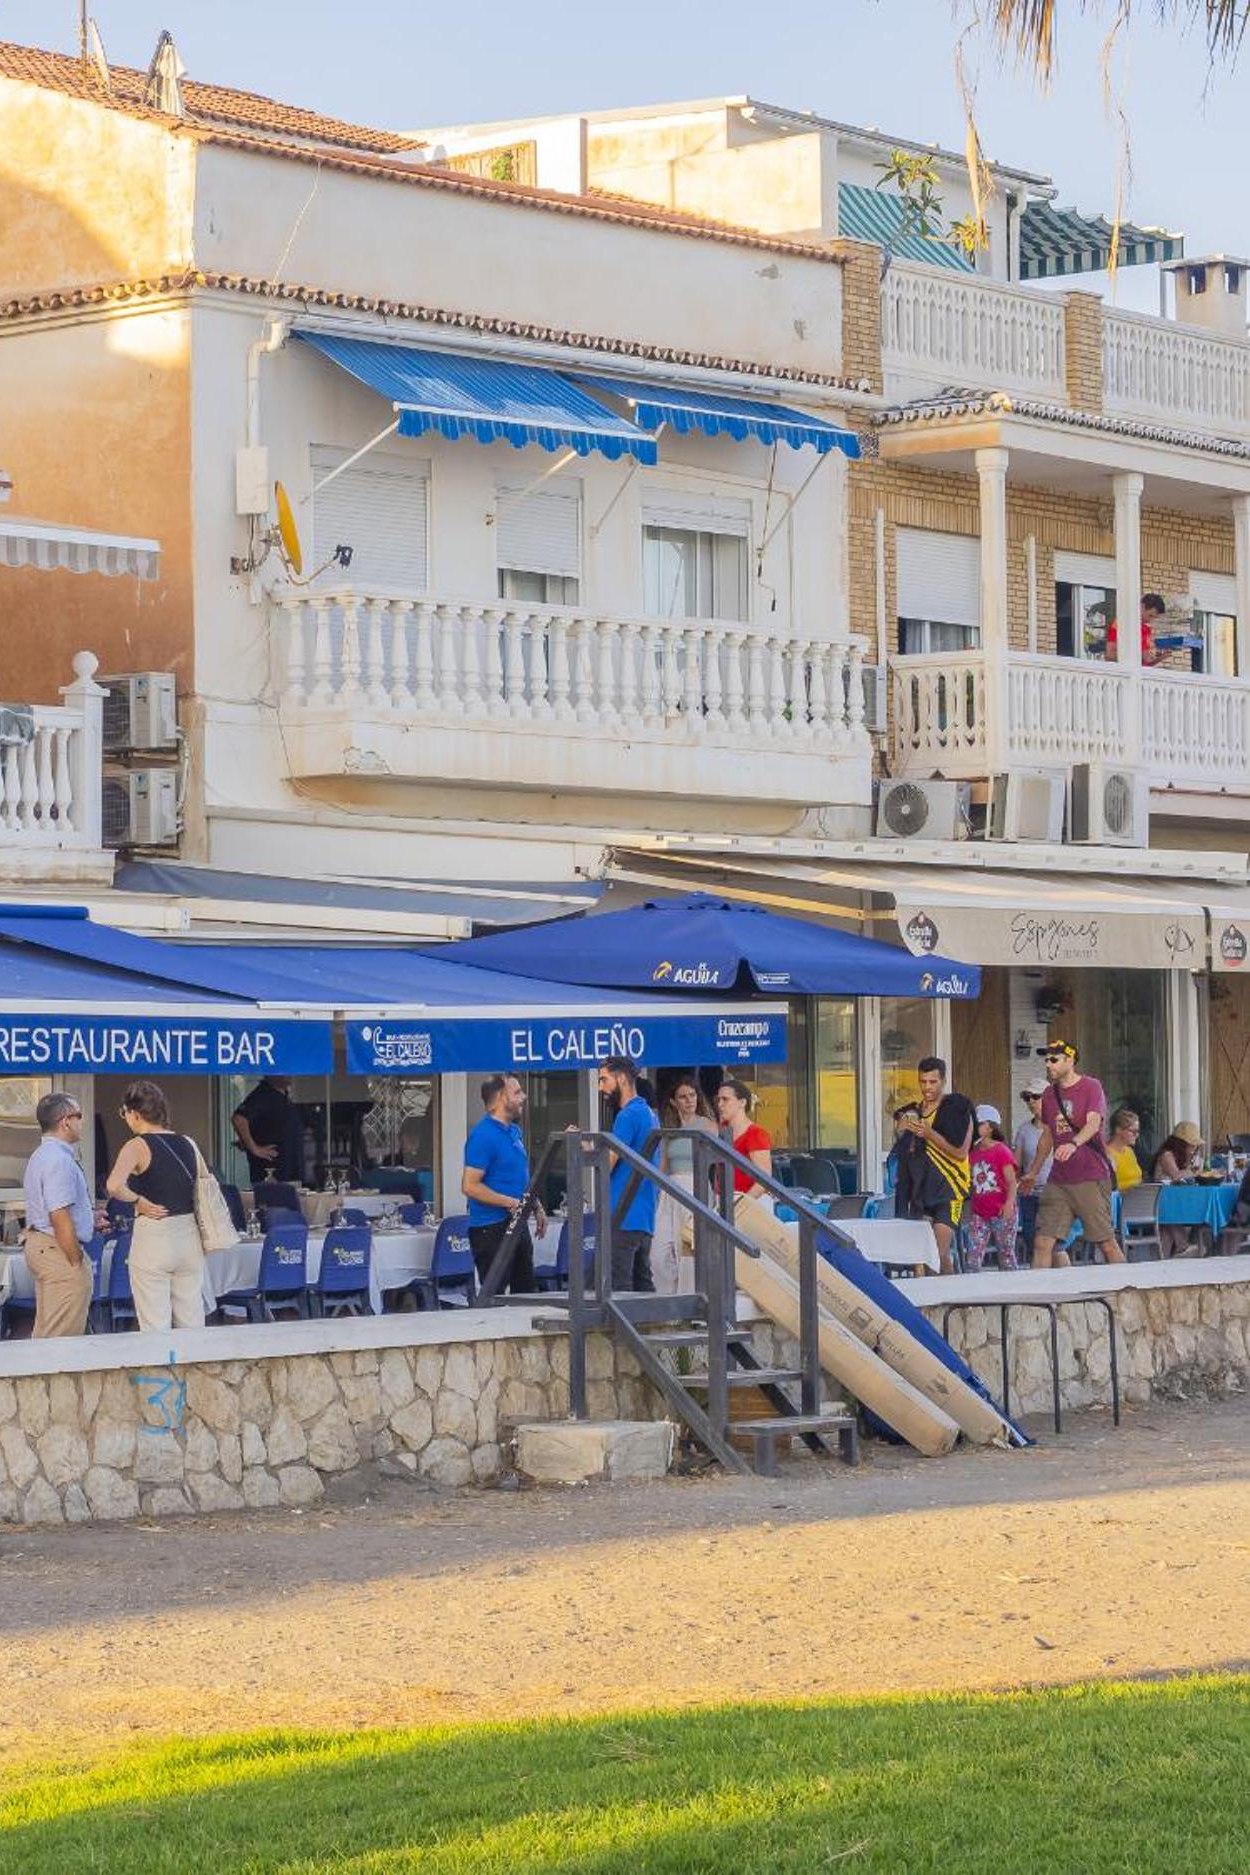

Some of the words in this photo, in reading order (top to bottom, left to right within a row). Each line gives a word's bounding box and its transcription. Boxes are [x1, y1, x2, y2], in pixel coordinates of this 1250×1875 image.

[511, 1030, 543, 1061] EL
[547, 1023, 645, 1060] CALEÑO
[718, 1019, 770, 1039] Cruzcampo
[217, 1030, 276, 1065] BAR
